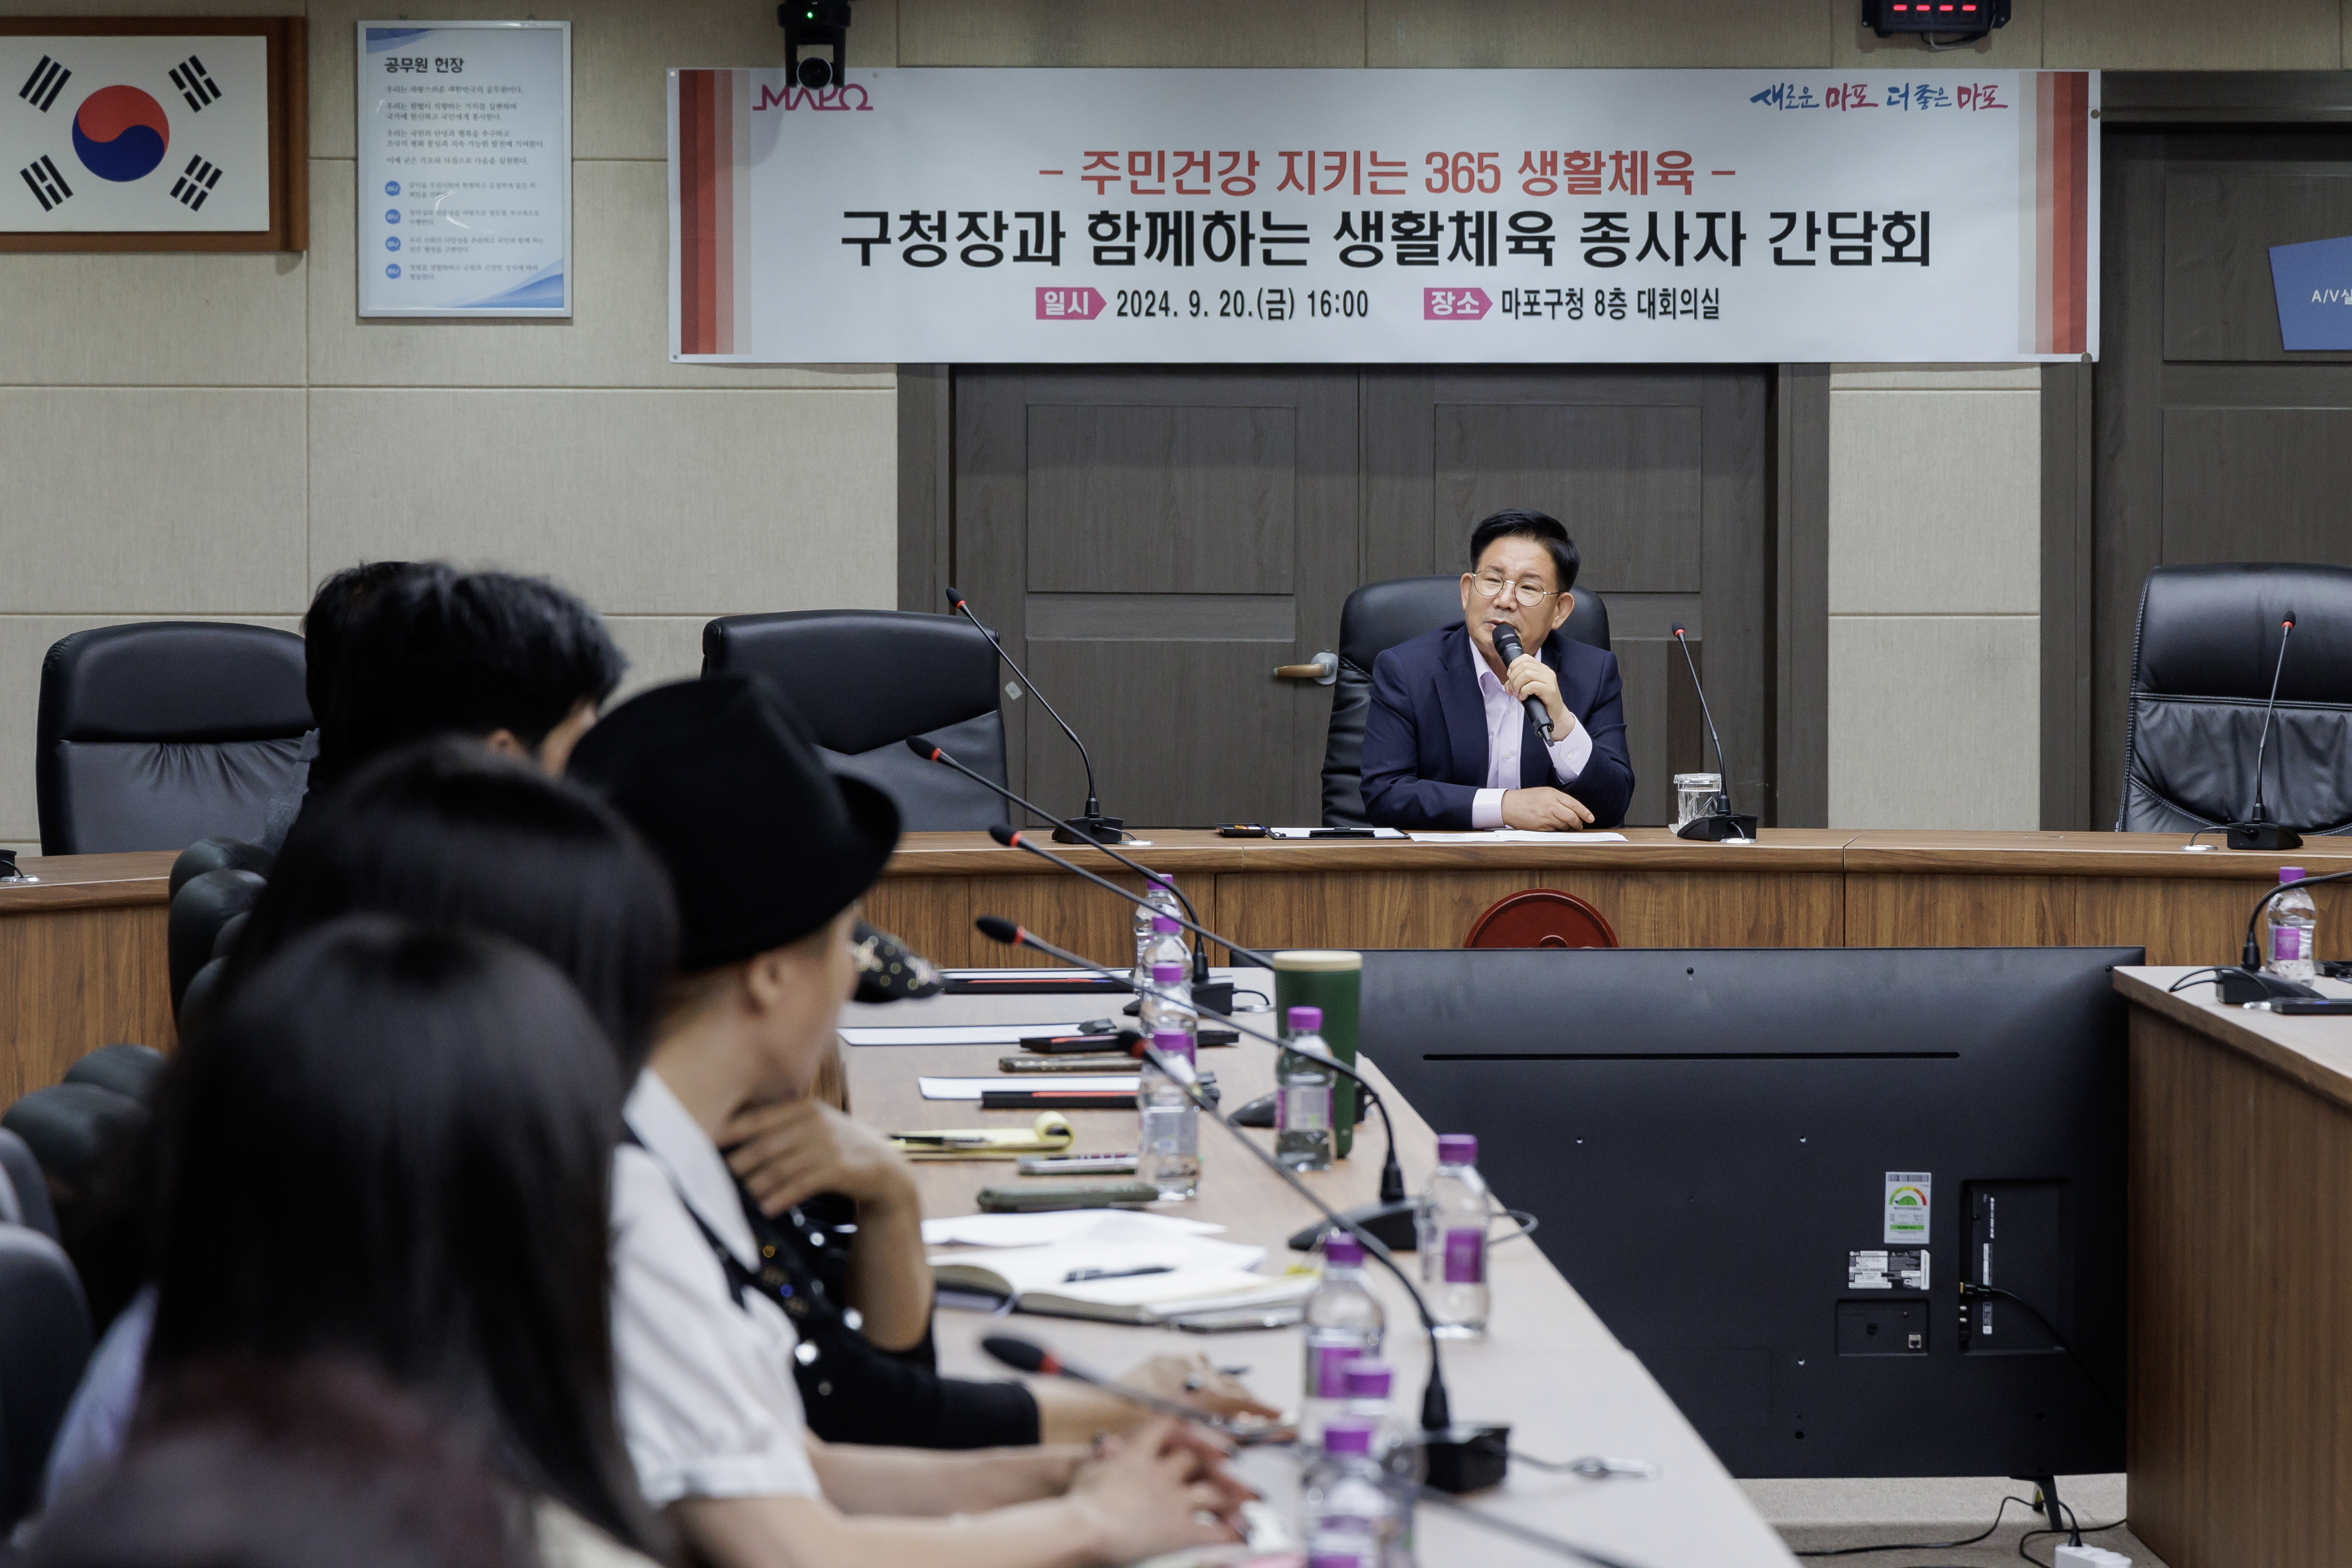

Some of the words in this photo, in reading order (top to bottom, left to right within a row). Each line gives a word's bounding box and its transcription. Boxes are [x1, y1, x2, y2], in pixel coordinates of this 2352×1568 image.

[385, 57, 428, 73] 공무원
[435, 57, 464, 73] 헌장
[1750, 82, 1819, 111] 새로운
[1825, 83, 1879, 112] 마포
[1886, 83, 1909, 112] 더
[1913, 84, 1952, 110] 좋은
[1957, 83, 2008, 112] 마포
[1081, 150, 1260, 197] 주민건강
[1277, 150, 1408, 195] 지키는
[1425, 151, 1500, 193] 365
[1519, 150, 1695, 197] 생활체육
[841, 209, 1066, 268] 구청장과
[1087, 209, 1310, 267] 함께하는
[1333, 210, 1556, 268] 생활체육
[1579, 210, 1747, 268] 종사자
[1768, 210, 1930, 267] 간담회
[1044, 291, 1088, 315] 일시
[1116, 289, 1178, 317] 2024.
[1189, 289, 1209, 317] 9.
[1219, 287, 1295, 320] 20.(금)
[1307, 289, 1368, 317] 16:00
[1431, 291, 1479, 315] 장소
[1502, 288, 1584, 320] 마포구청
[1594, 288, 1628, 320] 8층
[1637, 288, 1719, 320] 대회의실
